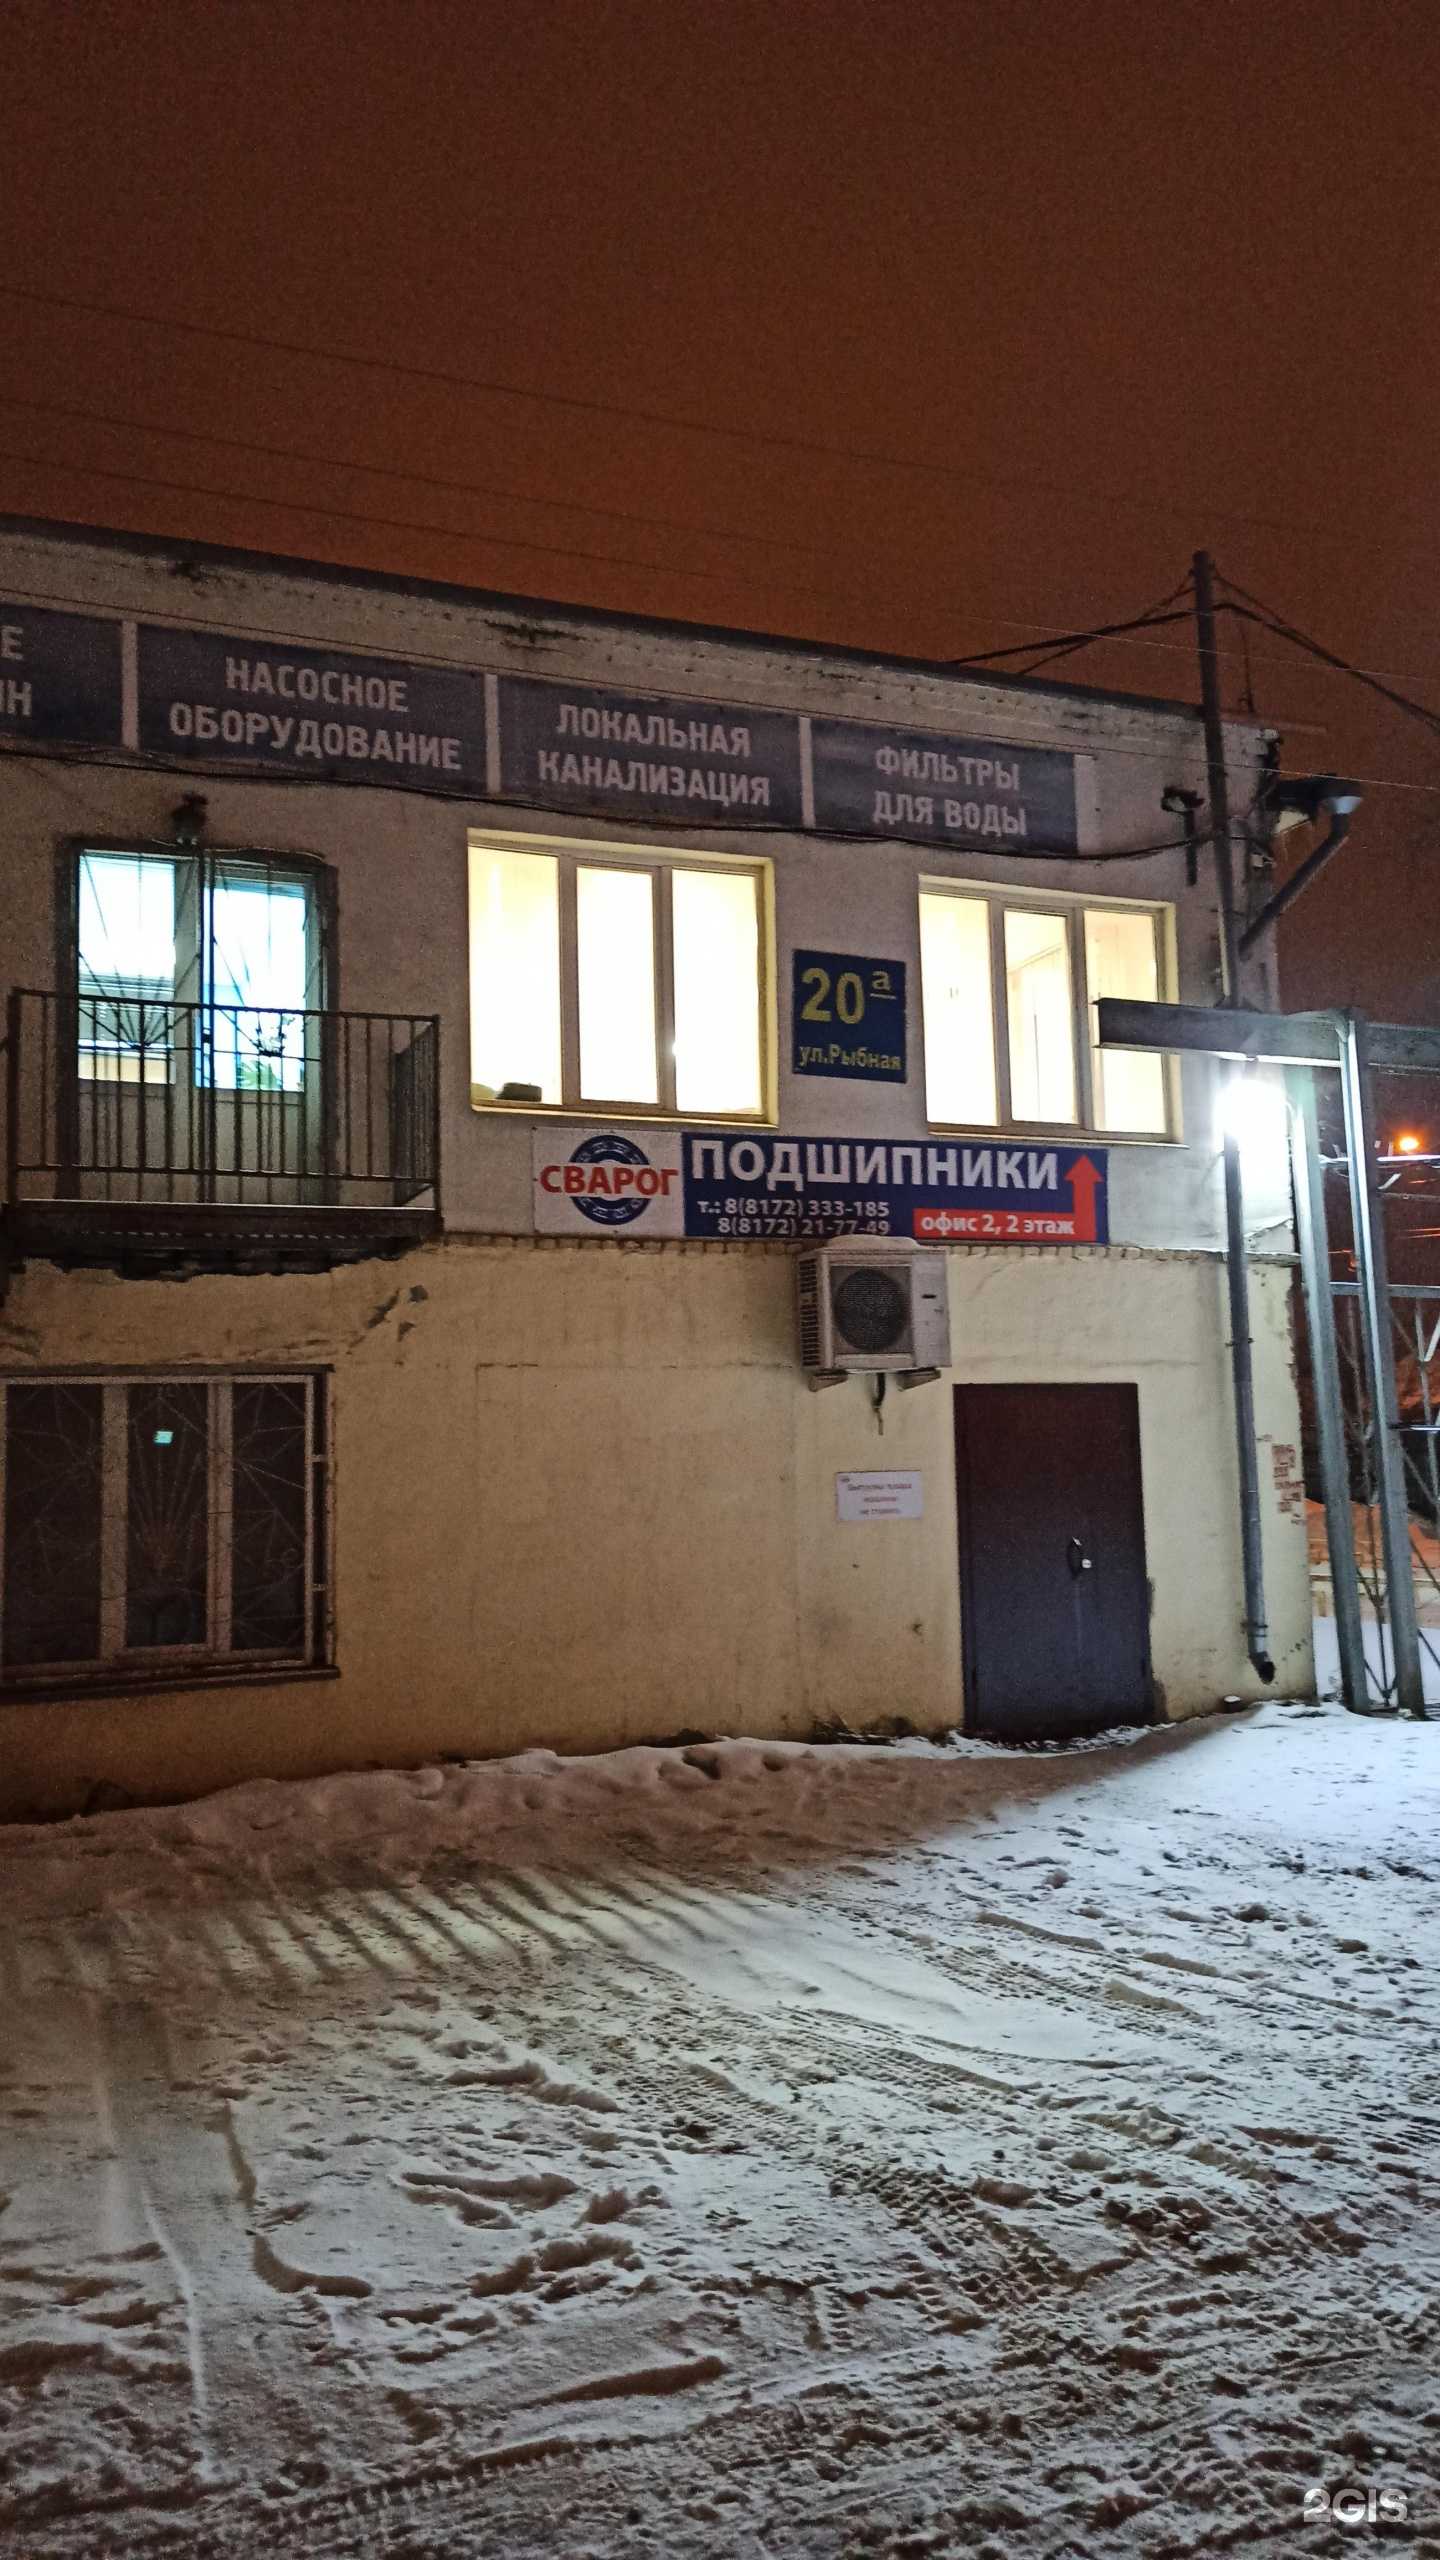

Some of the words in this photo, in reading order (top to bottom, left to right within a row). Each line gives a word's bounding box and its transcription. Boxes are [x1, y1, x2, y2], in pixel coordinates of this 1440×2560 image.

[0, 679, 33, 717] Н
[225, 656, 409, 713] НАСОСНОЕ
[169, 702, 463, 770] ОБОРУДОВАНИЕ
[556, 704, 751, 757] ЛОКАЛЬНАЯ
[538, 750, 770, 807] КАНАЛИЗАЦИЯ
[875, 746, 1020, 791] ФИЛЬТРЫ
[873, 790, 934, 825] ДЛЯ
[944, 799, 1027, 837] ВОДЫ
[539, 1165, 681, 1196] СВАРОГ
[691, 1139, 1059, 1191] ПОДШИПНИКИ
[717, 1217, 796, 1236] 8(8172)
[802, 1218, 890, 1236] 21-77-49
[725, 1198, 801, 1217] 8(8172)
[808, 1201, 890, 1218] 333-185
[921, 1211, 976, 1236] офис
[1007, 1214, 1019, 1232] 2
[1023, 1218, 1075, 1235] этаж
